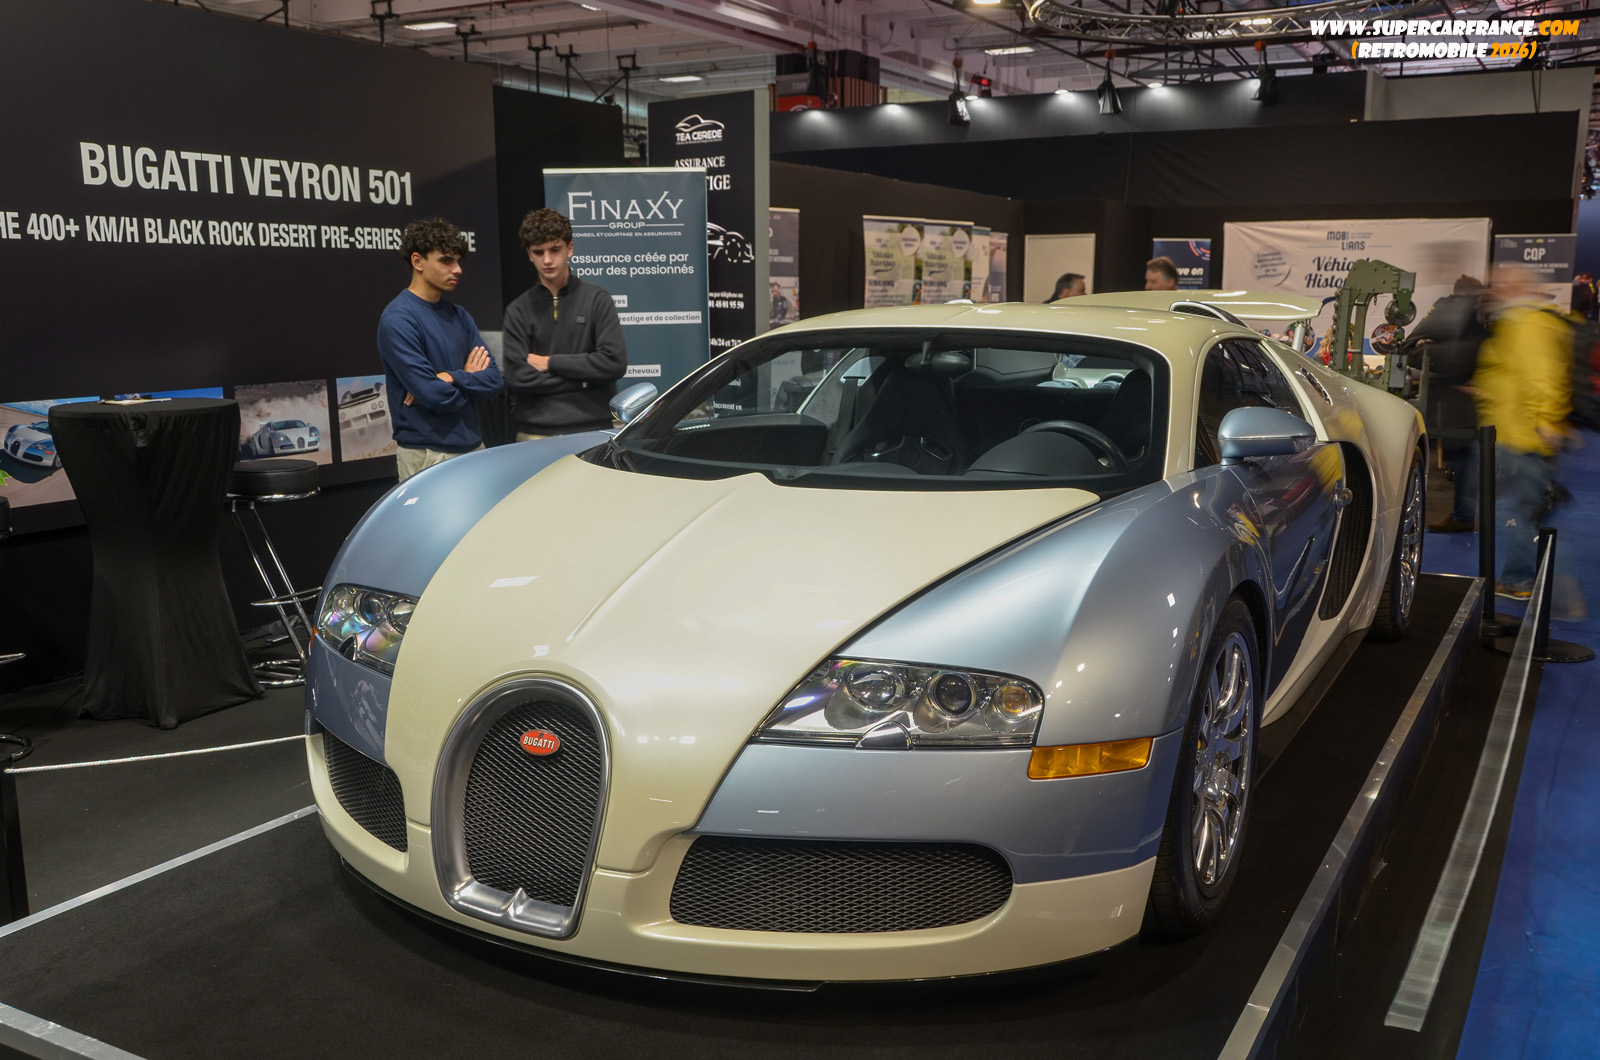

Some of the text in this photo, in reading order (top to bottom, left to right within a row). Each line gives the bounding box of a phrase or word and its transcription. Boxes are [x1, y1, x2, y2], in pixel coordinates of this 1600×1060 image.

[675, 132, 691, 142] TEA
[692, 129, 723, 141] CEREDE
[675, 155, 726, 168] ASSURANCE
[80, 141, 412, 206] BUGATTI VEYRON 501
[27, 212, 80, 241] 400+
[85, 215, 139, 243] KM/H
[144, 217, 203, 246] BLACK
[209, 220, 256, 248] ROCK
[258, 222, 317, 249] DESERT
[321, 225, 402, 251] PRE-SERIES
[608, 221, 646, 229] GROUP
[570, 251, 690, 265] assurance créée par
[1523, 247, 1546, 261] CQP
[577, 267, 604, 279] pour
[606, 265, 628, 276] des
[630, 264, 695, 278] passionnés
[619, 314, 644, 324] restige
[664, 313, 700, 321] collection
[628, 367, 660, 375] chevaux
[523, 736, 555, 750] BUGATTI
